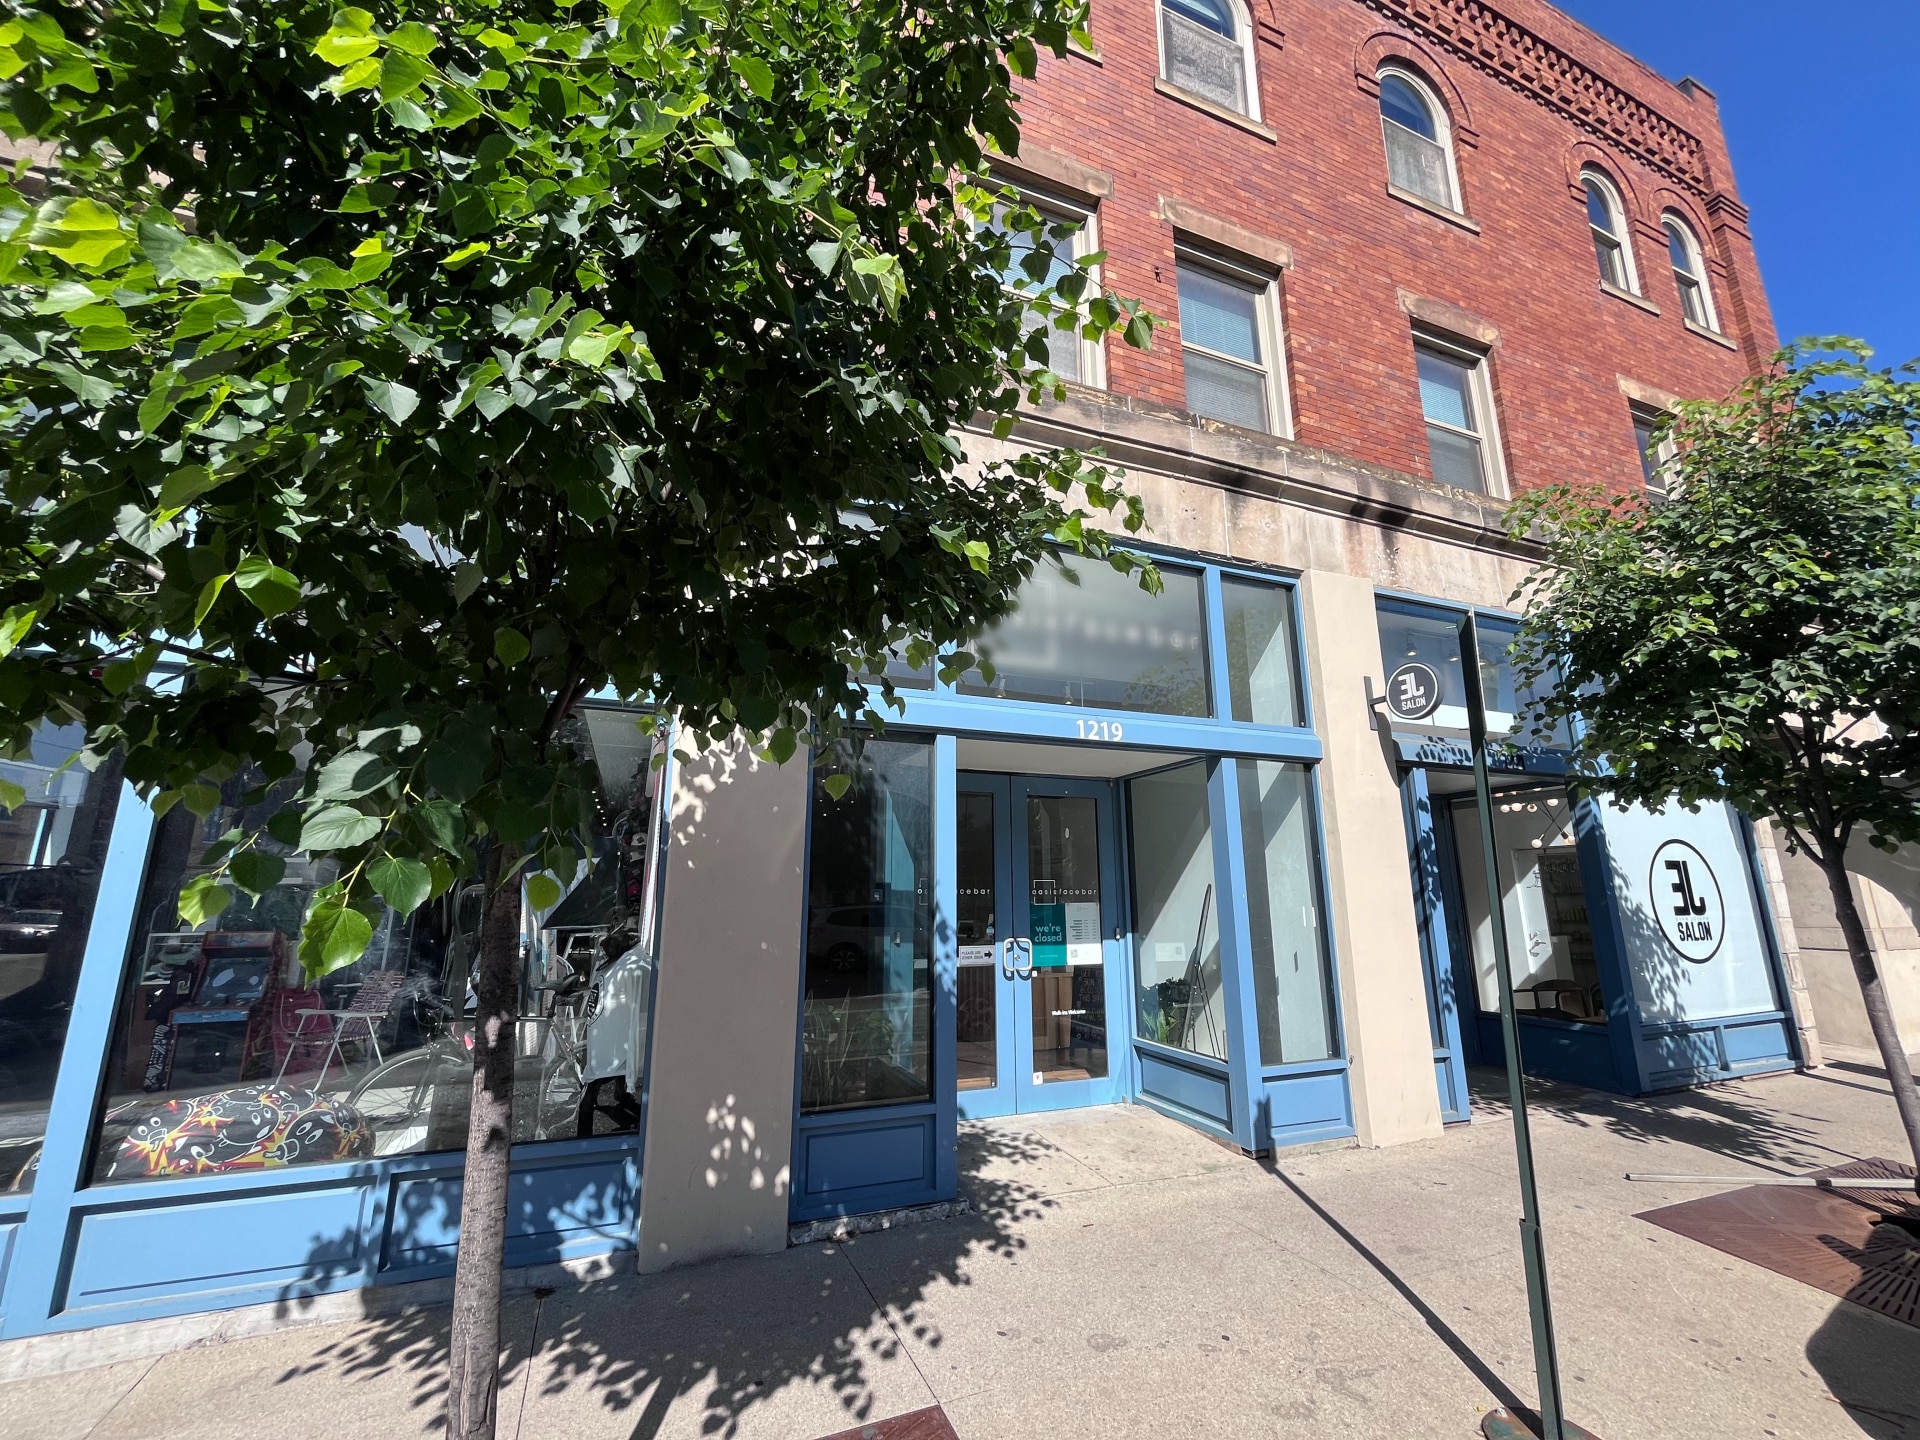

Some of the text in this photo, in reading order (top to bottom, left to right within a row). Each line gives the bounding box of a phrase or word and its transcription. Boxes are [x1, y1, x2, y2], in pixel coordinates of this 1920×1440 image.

[1401, 696, 1427, 711] SALON
[1076, 719, 1123, 742] 1219
[1034, 923, 1062, 933] we're
[1677, 921, 1713, 942] SALON
[1034, 932, 1062, 942] closed
